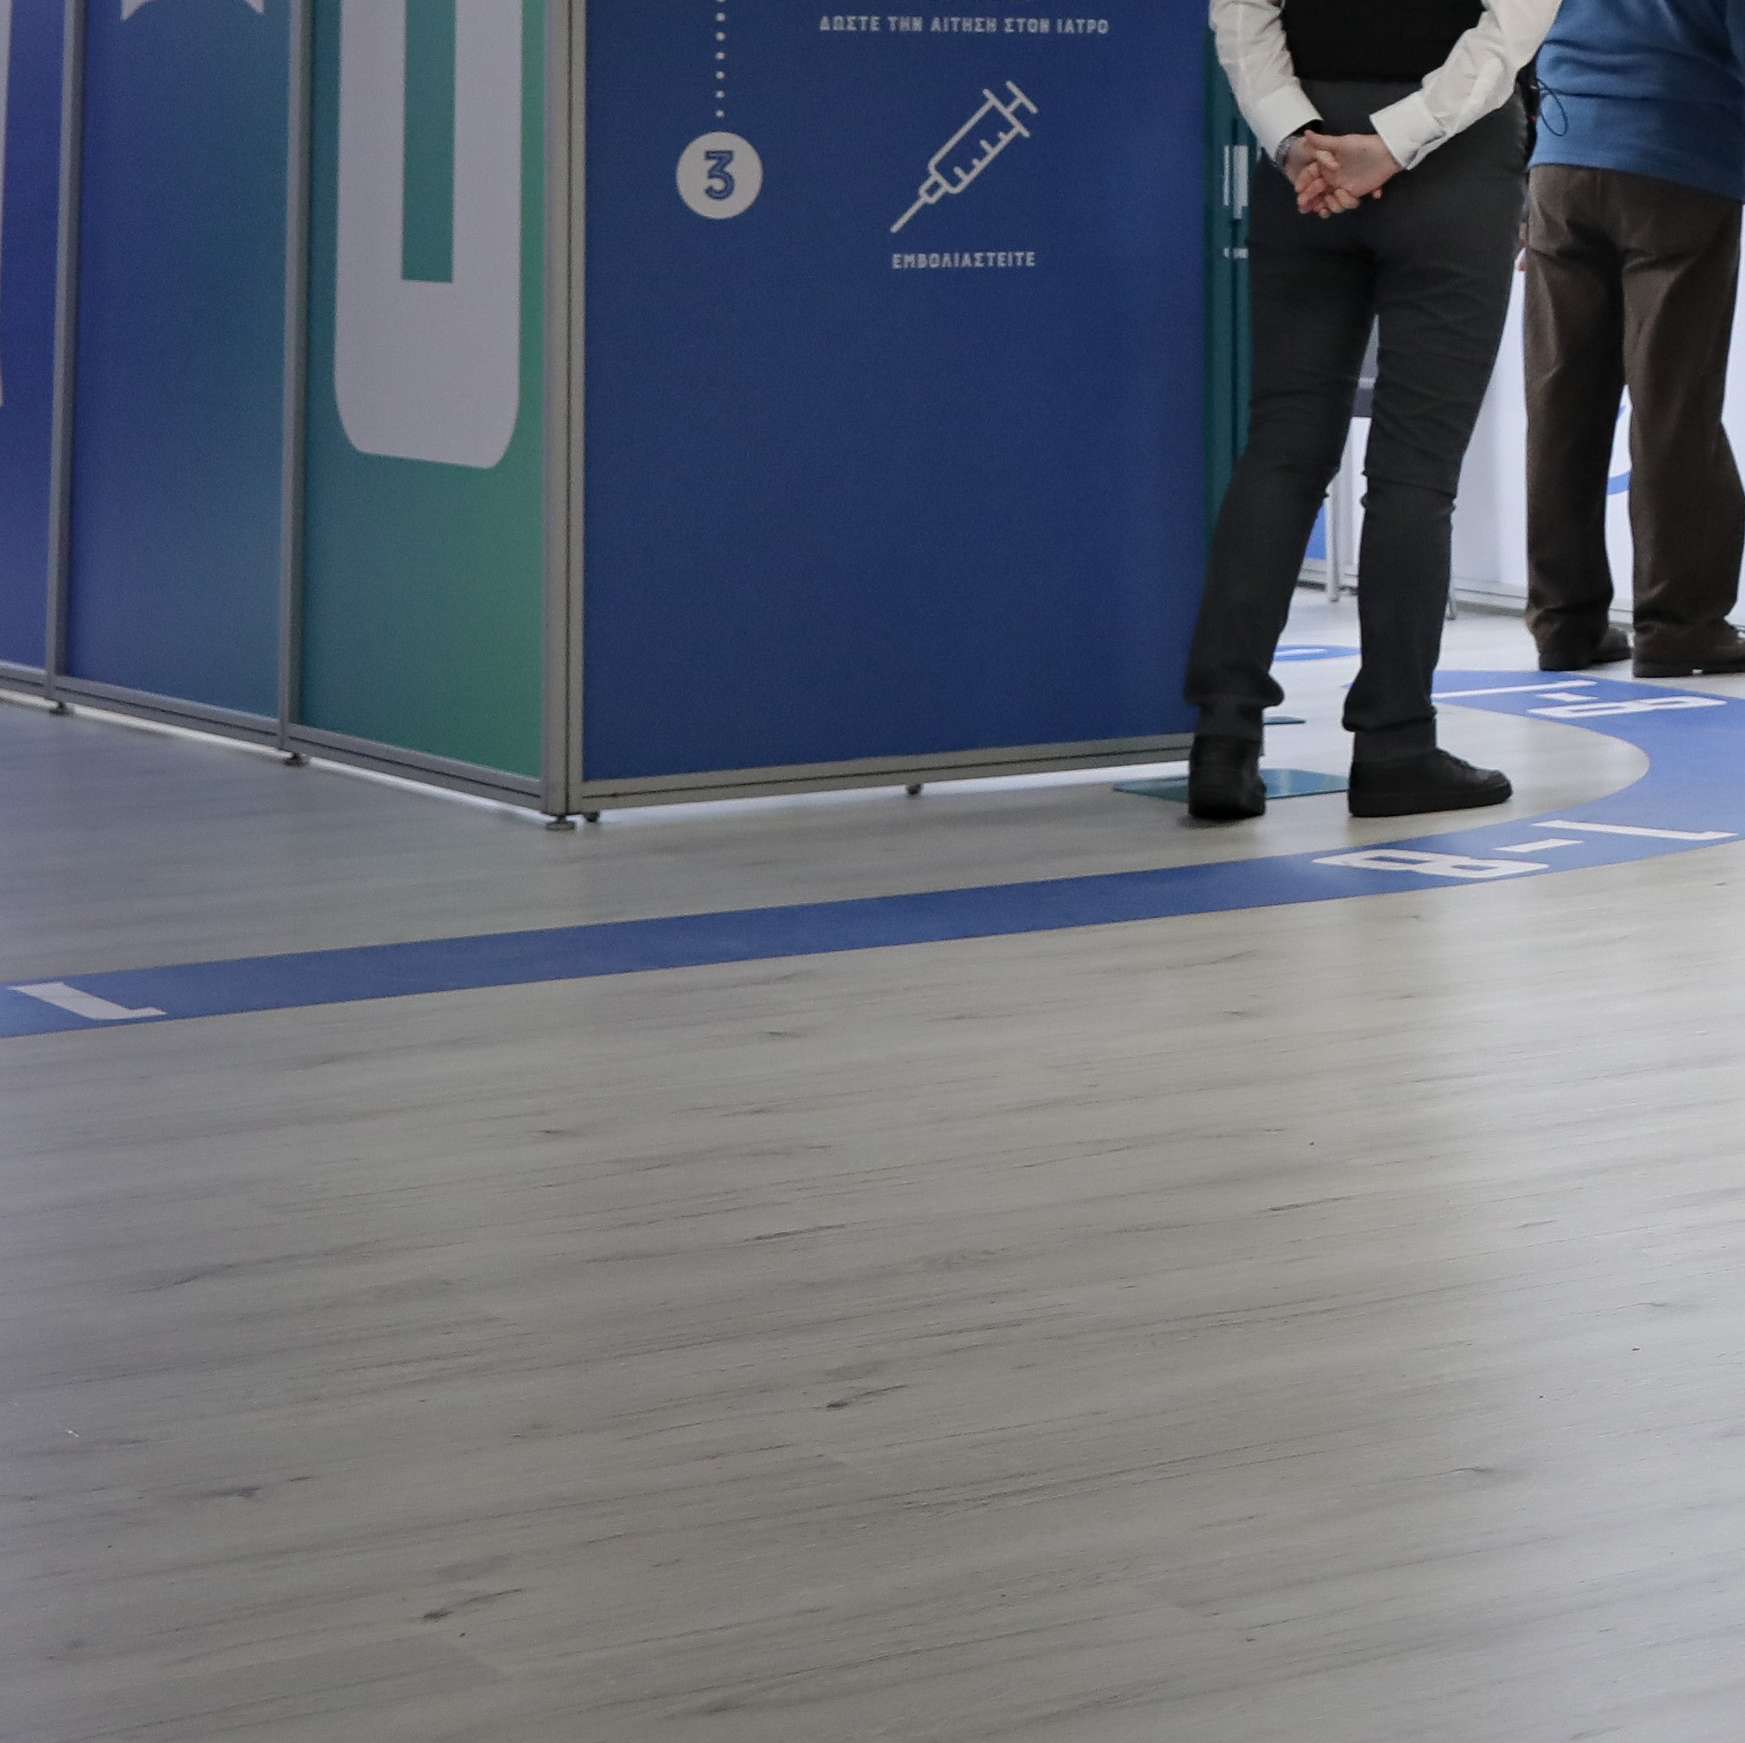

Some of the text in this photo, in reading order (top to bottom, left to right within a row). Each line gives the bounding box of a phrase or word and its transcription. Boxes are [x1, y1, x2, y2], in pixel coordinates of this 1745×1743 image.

[819, 15, 1110, 35] ΔΩΣΤΕ ΤΗΝ ΑΙΤΗΣΗ ΣΤΟΝ ΙΑΤΡΟ
[702, 149, 736, 201] 3
[891, 250, 1036, 270] ΕΜΒΟΛΙΑΣΤΕΙΤΕ
